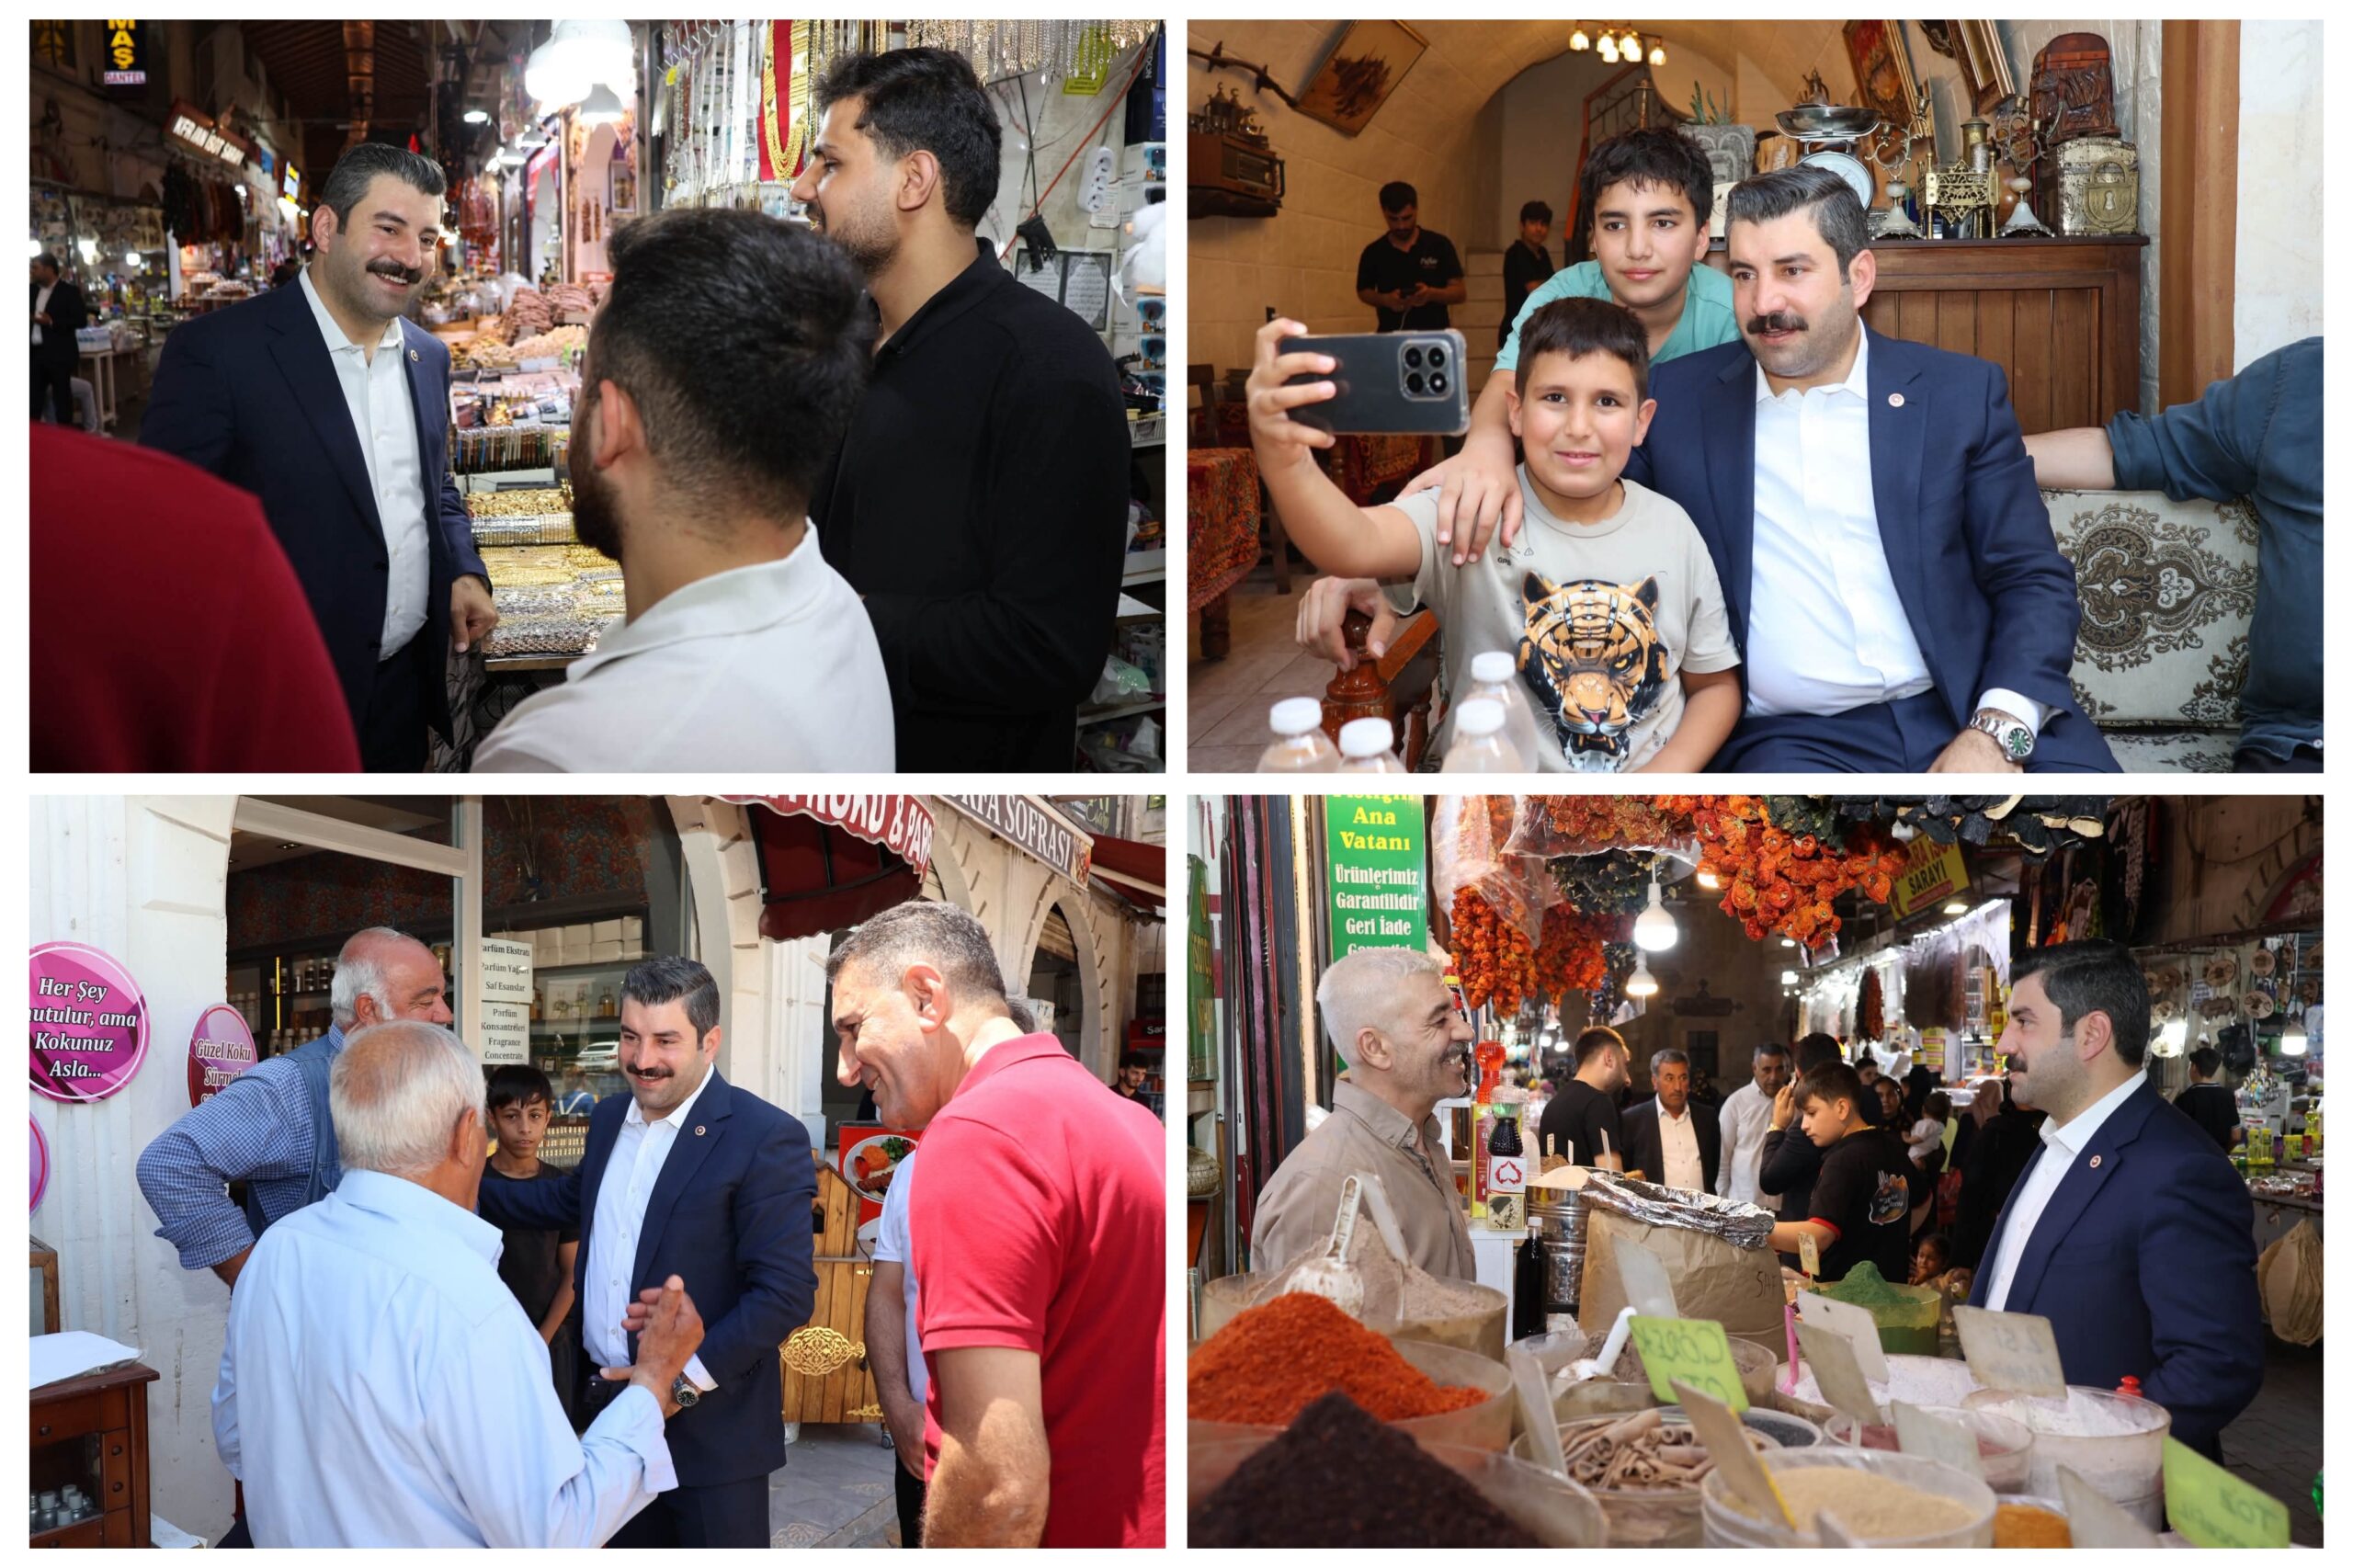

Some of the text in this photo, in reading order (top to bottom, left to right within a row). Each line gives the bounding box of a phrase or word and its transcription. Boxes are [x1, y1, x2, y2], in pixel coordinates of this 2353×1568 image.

[1353, 806, 1396, 825] Ana
[1004, 795, 1072, 871] SOFRASI
[1339, 831, 1411, 851] Vatanı
[1335, 863, 1418, 886] Ürünlerimiz
[1908, 858, 1948, 895] SARAYI
[1336, 892, 1419, 911] Garantilidir
[1345, 915, 1412, 936] Geri İade
[482, 943, 506, 954] arfüm
[39, 977, 108, 1004] Her Şey
[485, 981, 526, 993] Saf Esanslar
[98, 1012, 137, 1028] ama
[493, 1007, 517, 1018] Parfüm
[35, 1031, 114, 1052] Kokunuz
[196, 1039, 252, 1062] Güzel Koku
[488, 1037, 521, 1048] Fragrance
[484, 1051, 524, 1060] Concentrate
[49, 1060, 102, 1078] Asla...
